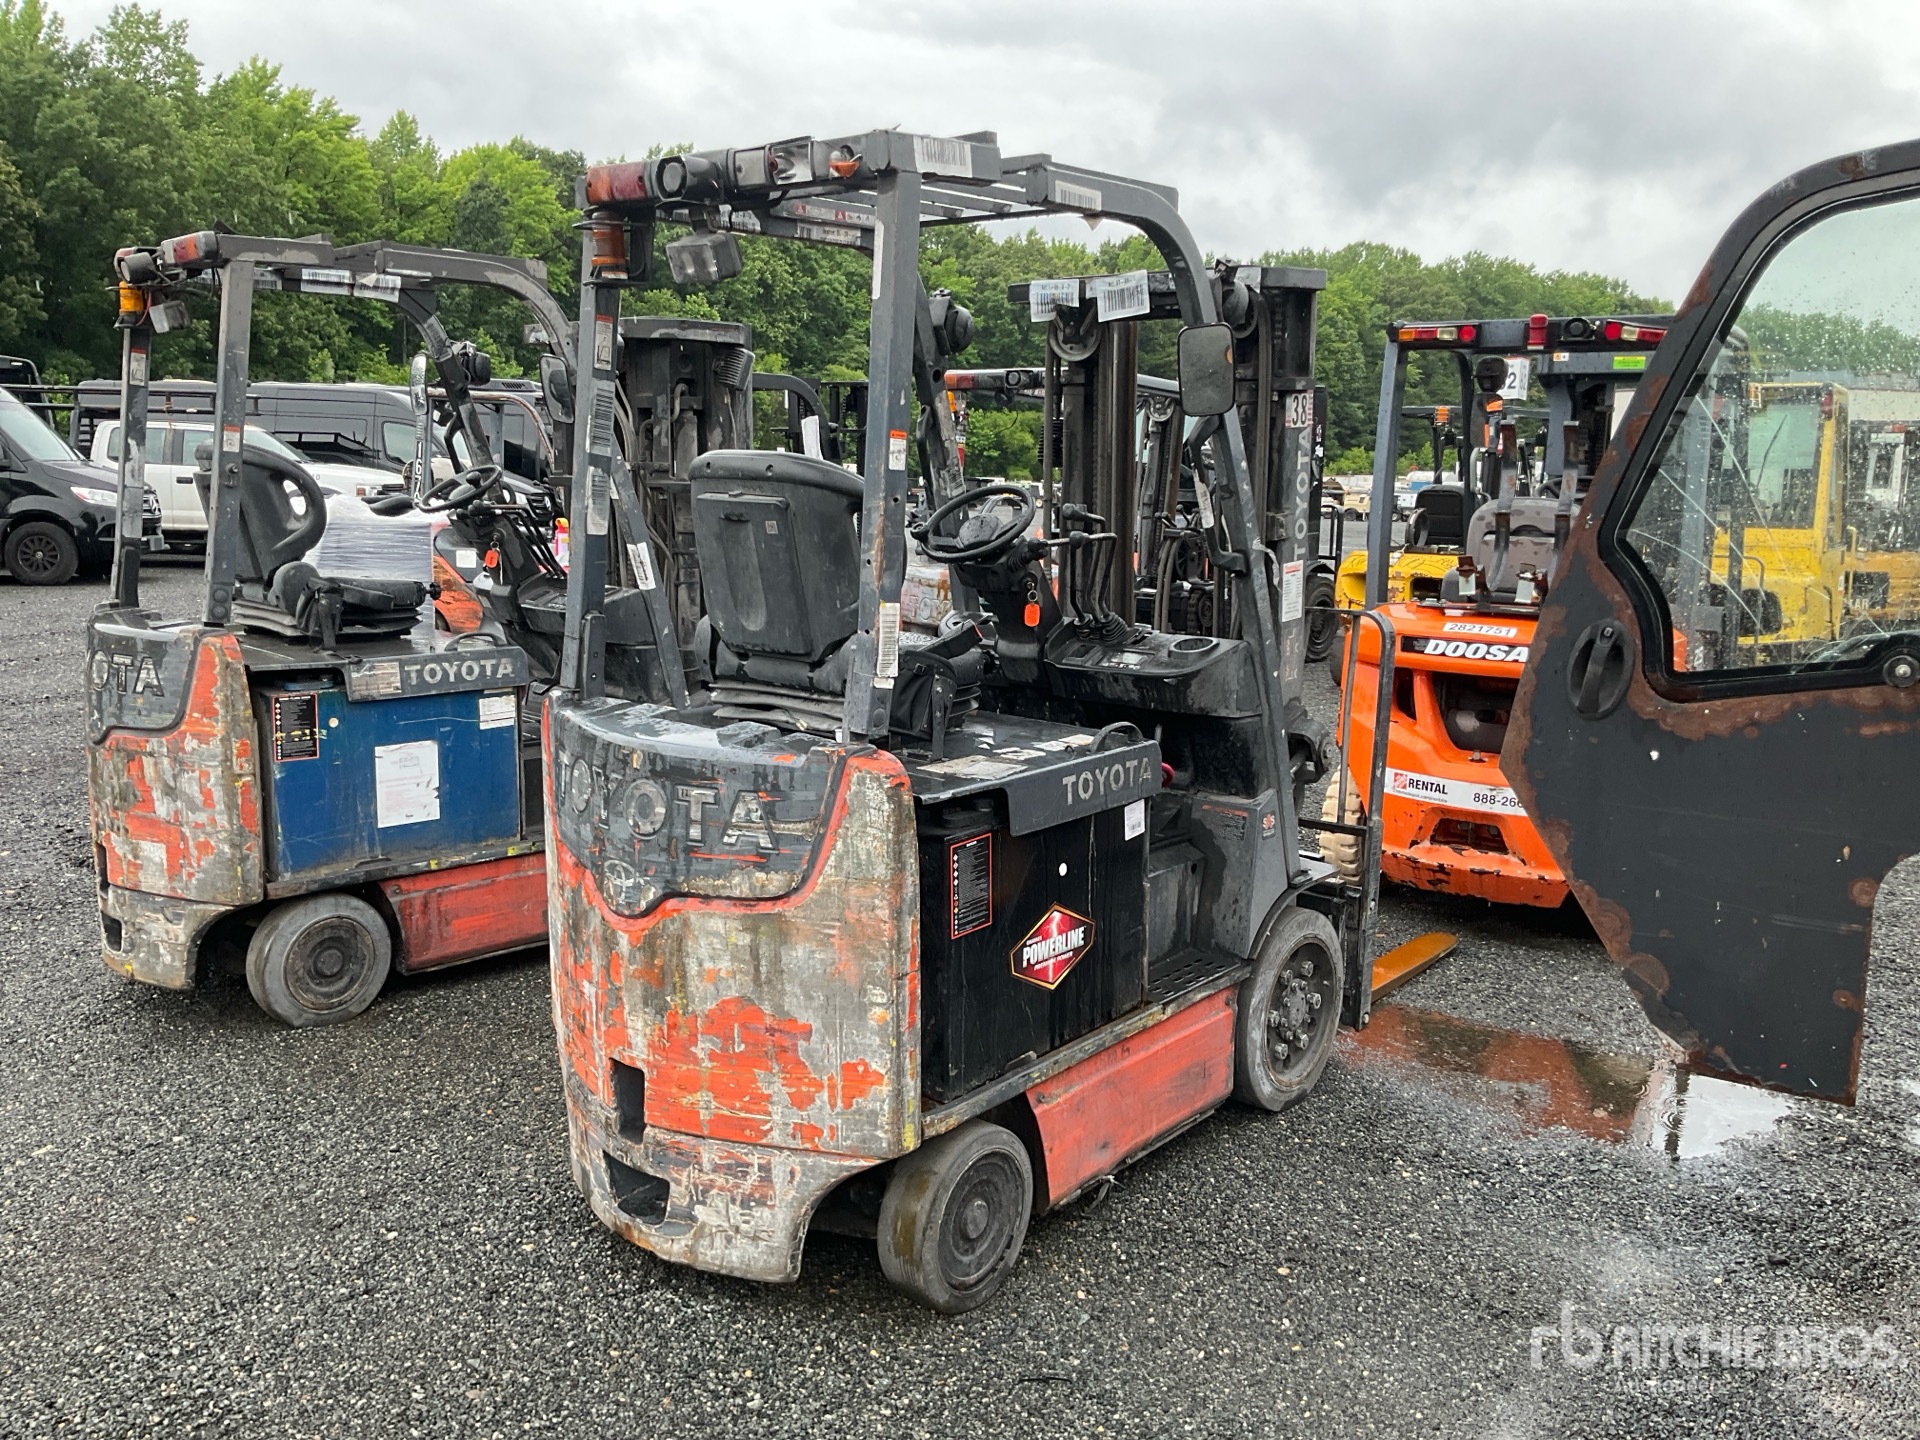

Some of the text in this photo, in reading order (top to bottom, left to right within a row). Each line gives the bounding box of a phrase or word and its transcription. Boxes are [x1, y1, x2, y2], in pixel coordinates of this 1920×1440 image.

[1291, 392, 1309, 427] 38
[1294, 427, 1312, 562] TOYOTA
[1448, 622, 1512, 636] 2821751
[404, 657, 515, 685] TOYOTA
[557, 749, 780, 853] TOYOTA
[1062, 757, 1152, 806] TOYOTA
[1408, 778, 1448, 795] RENTAL
[1022, 926, 1086, 969] POWERLINE
